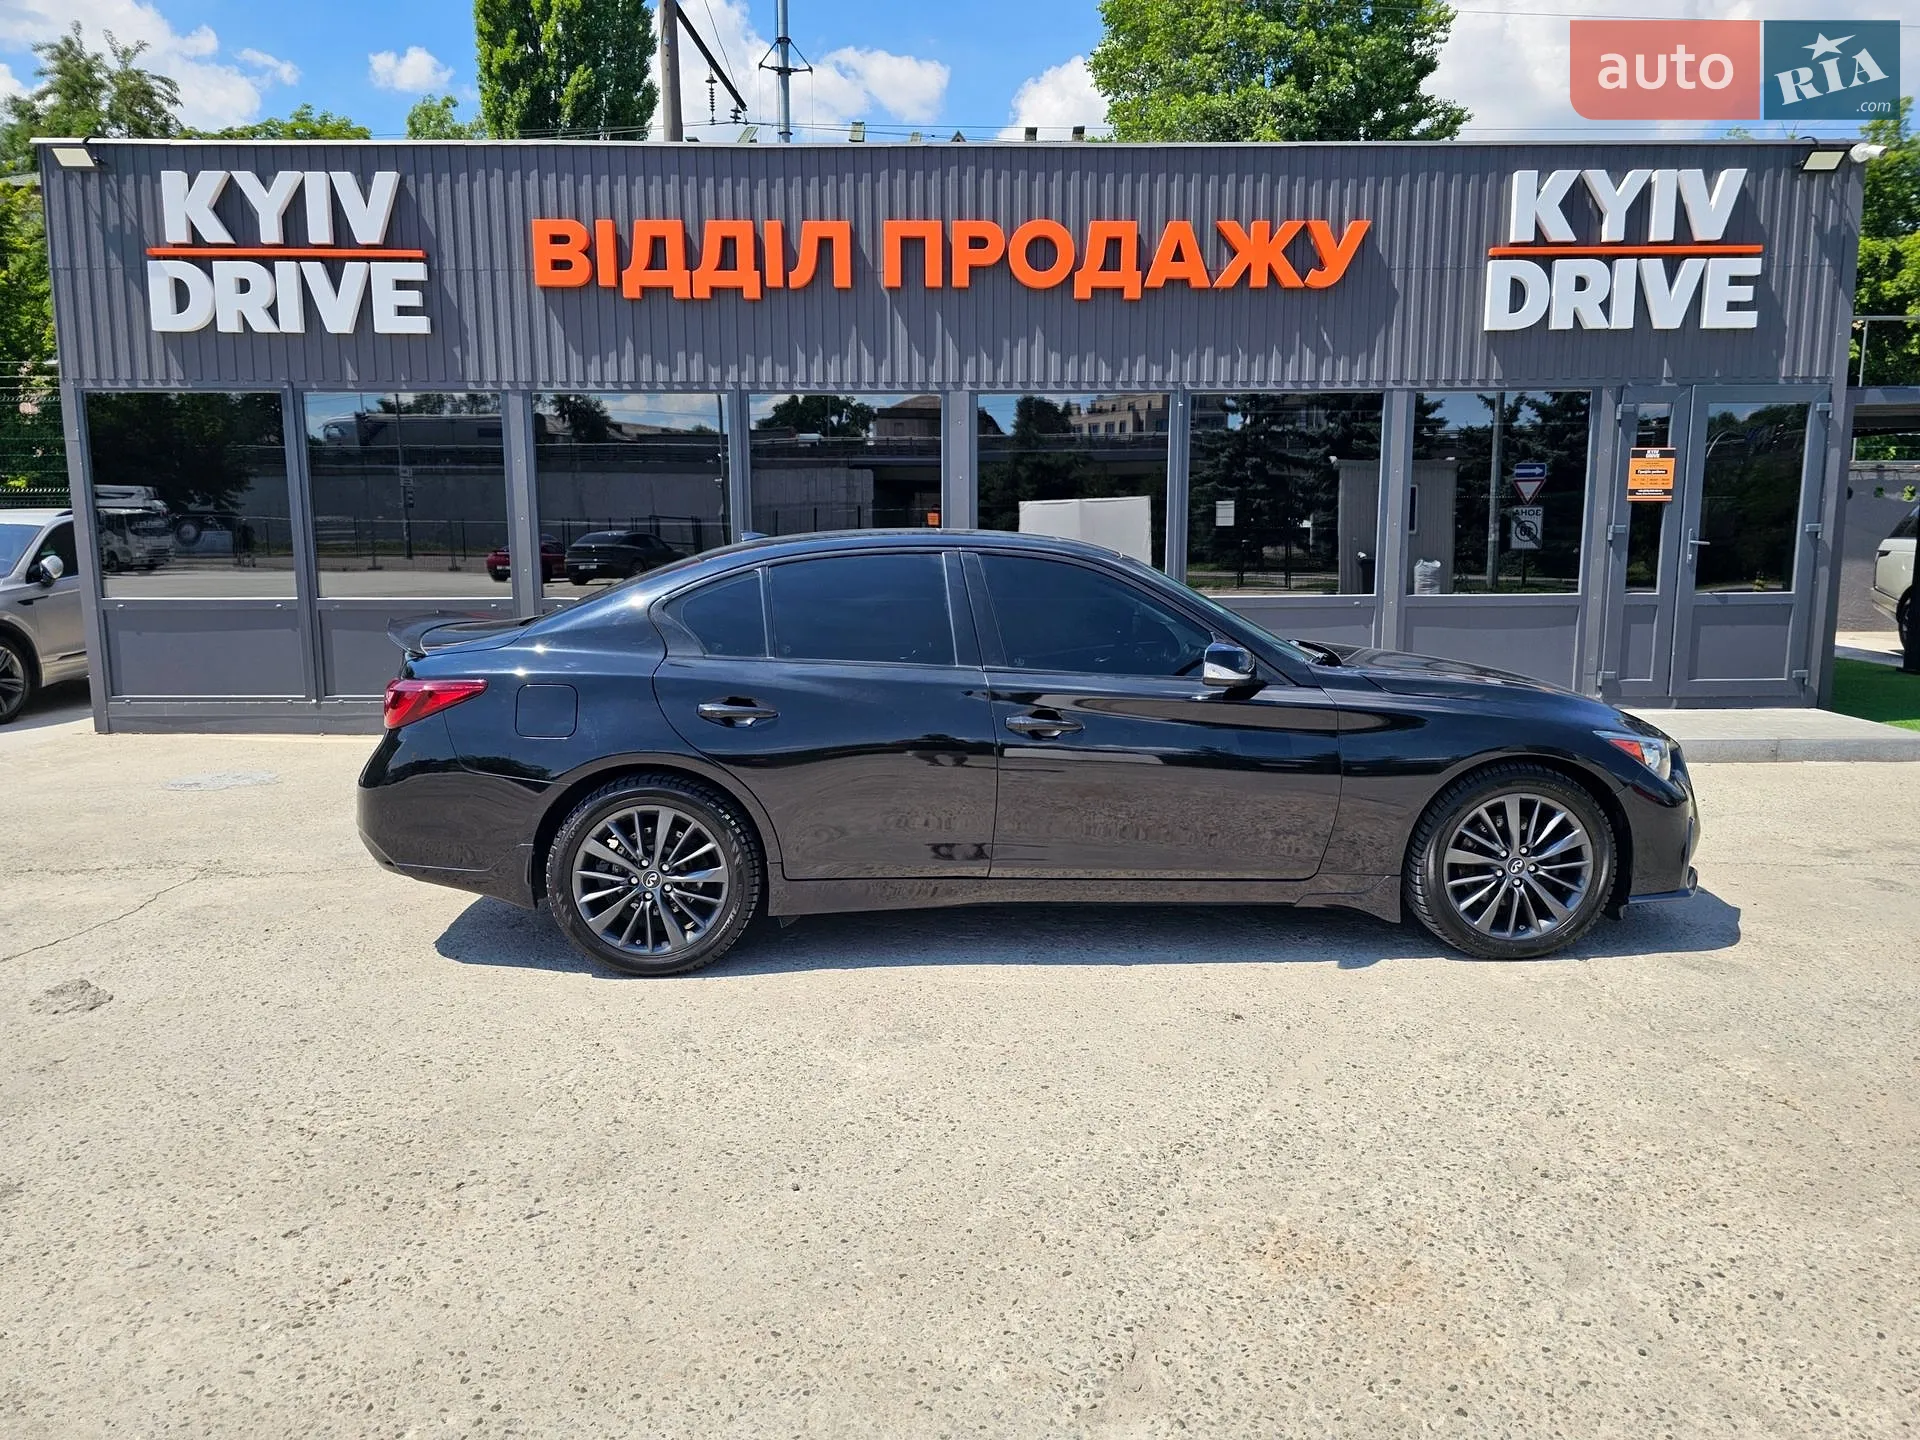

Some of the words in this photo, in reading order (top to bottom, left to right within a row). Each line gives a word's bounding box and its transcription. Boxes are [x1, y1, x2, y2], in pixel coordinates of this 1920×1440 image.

[160, 170, 400, 245] KYIV
[1508, 168, 1749, 243] KYIV
[531, 218, 853, 300] ВІДДІЛ
[882, 218, 1371, 300] ПРОДАЖУ
[1483, 257, 1763, 331] DRIVE
[147, 260, 432, 334] DRIVE
